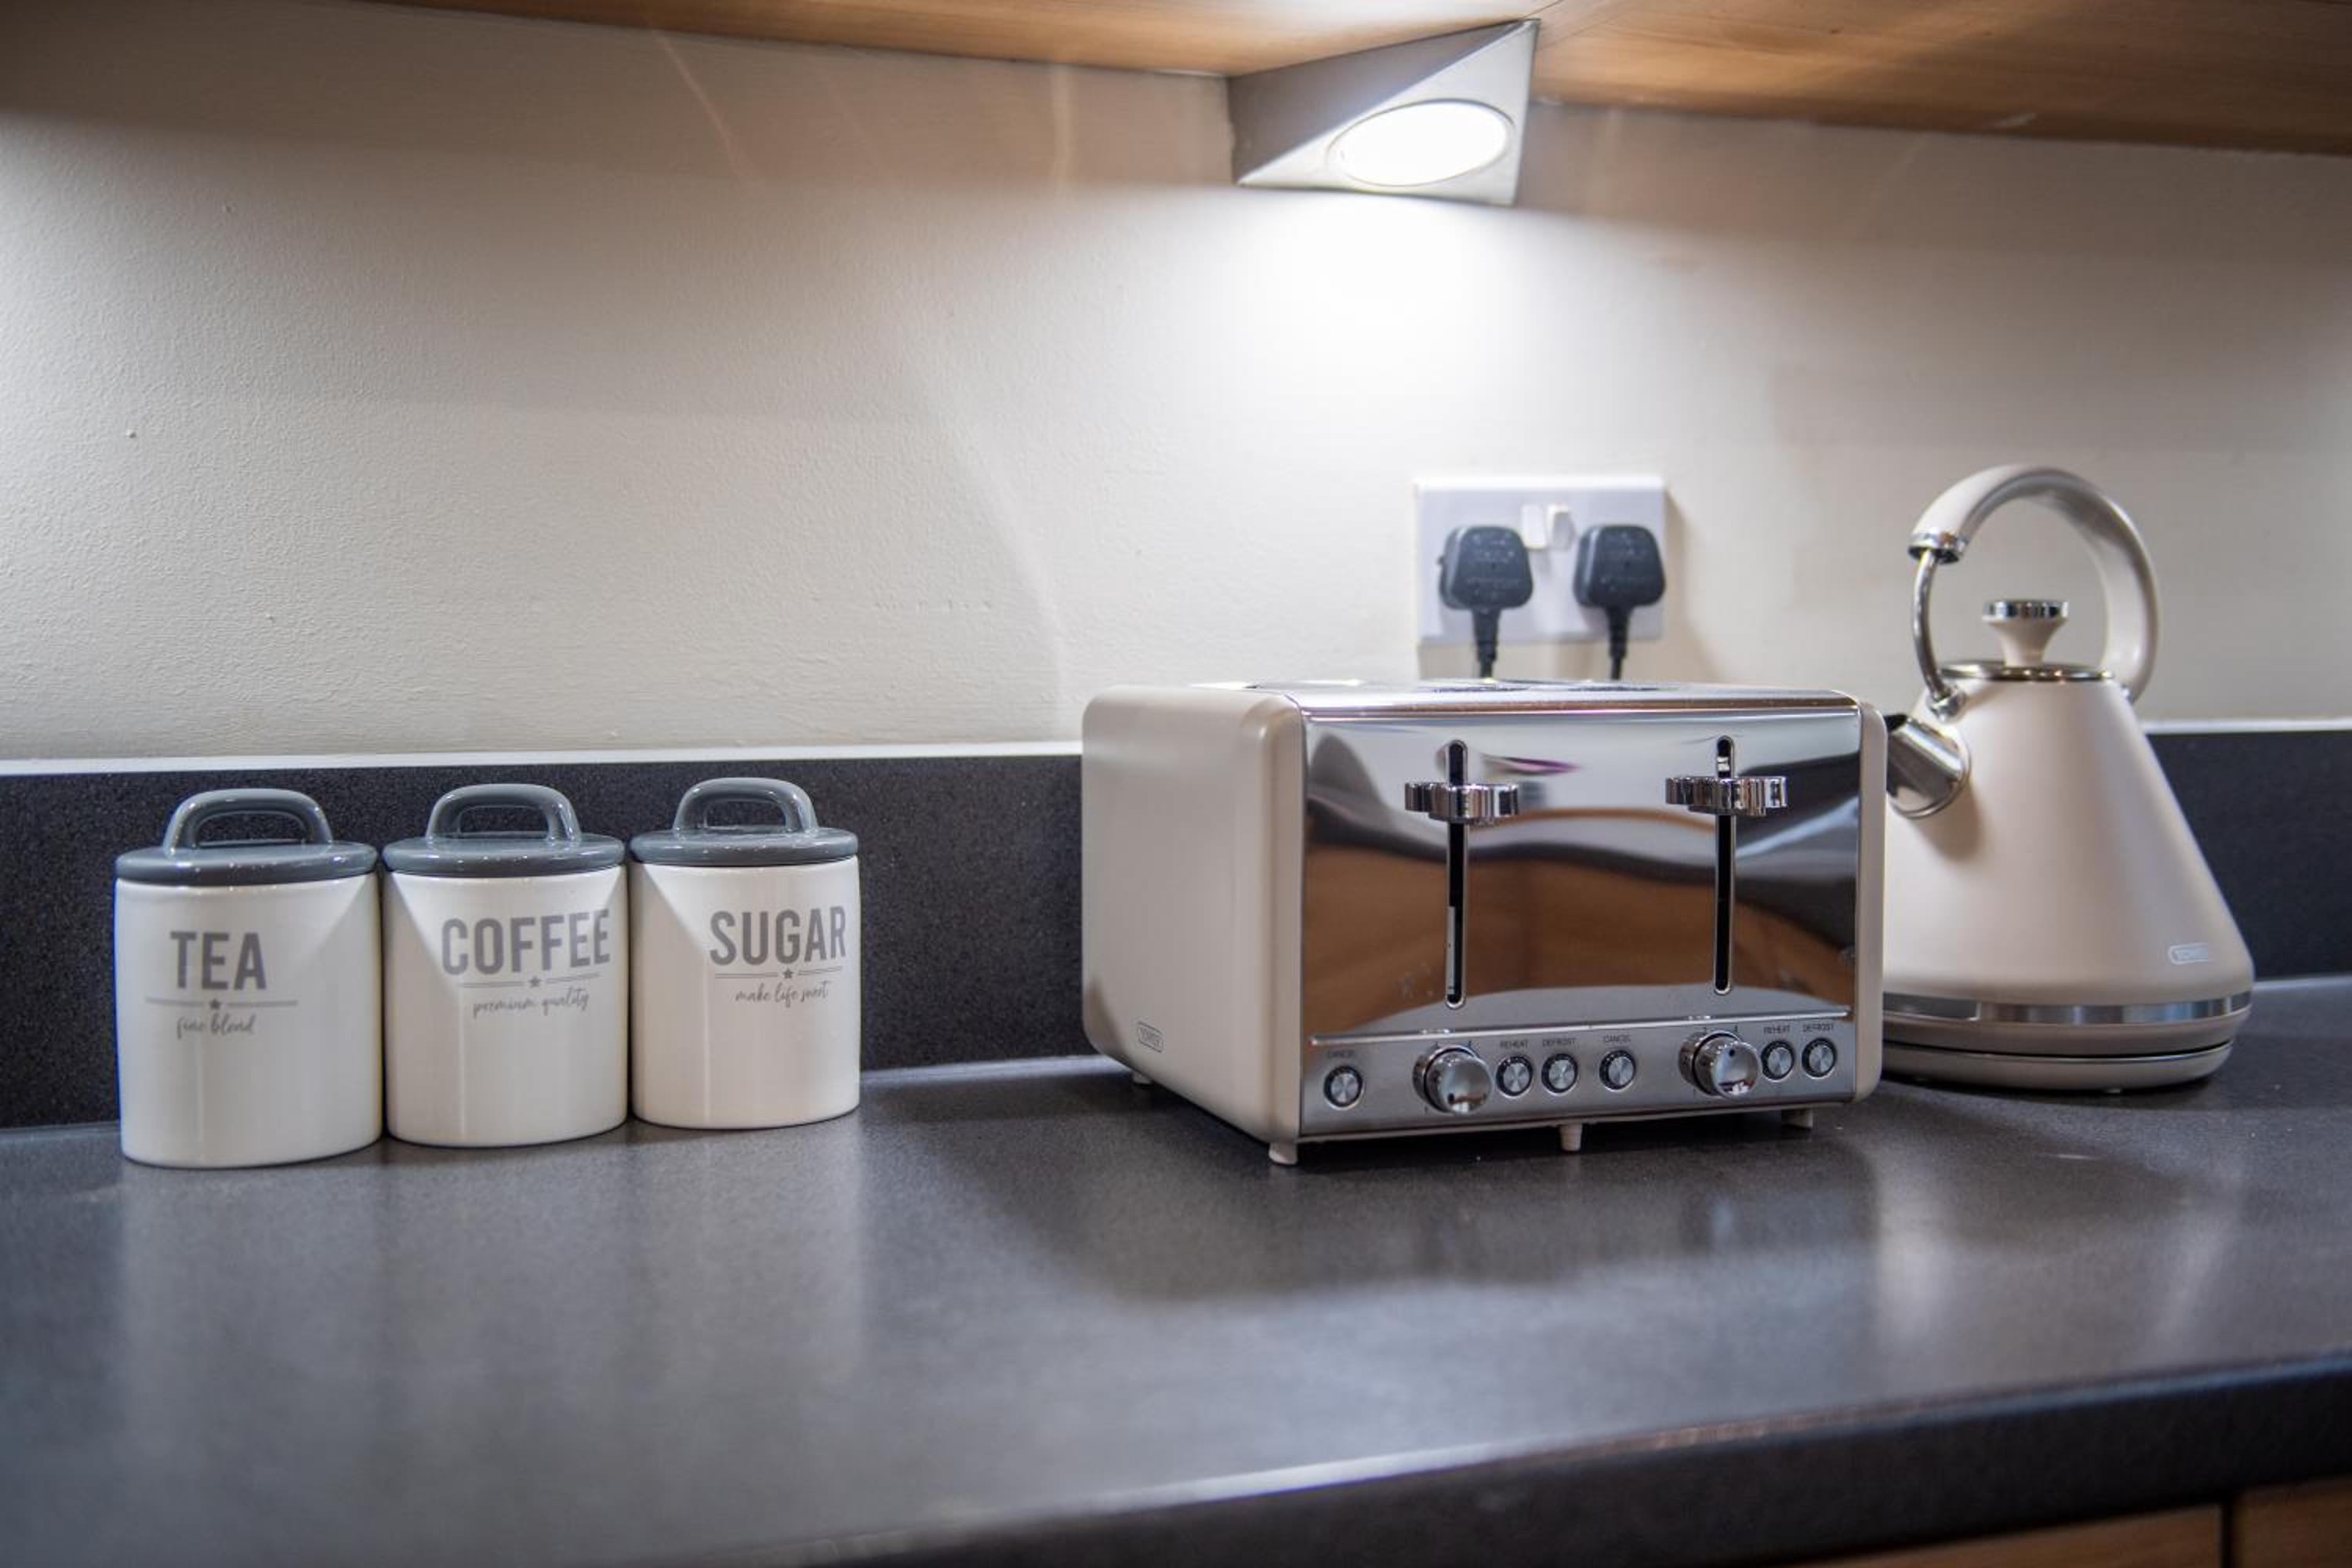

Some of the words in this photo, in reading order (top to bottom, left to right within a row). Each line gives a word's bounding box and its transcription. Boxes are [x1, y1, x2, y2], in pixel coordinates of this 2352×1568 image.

[441, 909, 611, 975] COFFEE
[710, 906, 846, 966] SUGAR
[169, 931, 267, 990] TEA
[472, 997, 536, 1019] premium
[541, 985, 590, 1016] quality
[735, 982, 771, 1002] make
[774, 982, 798, 1008] life
[176, 1015, 205, 1040] fine
[209, 1013, 256, 1035] blend
